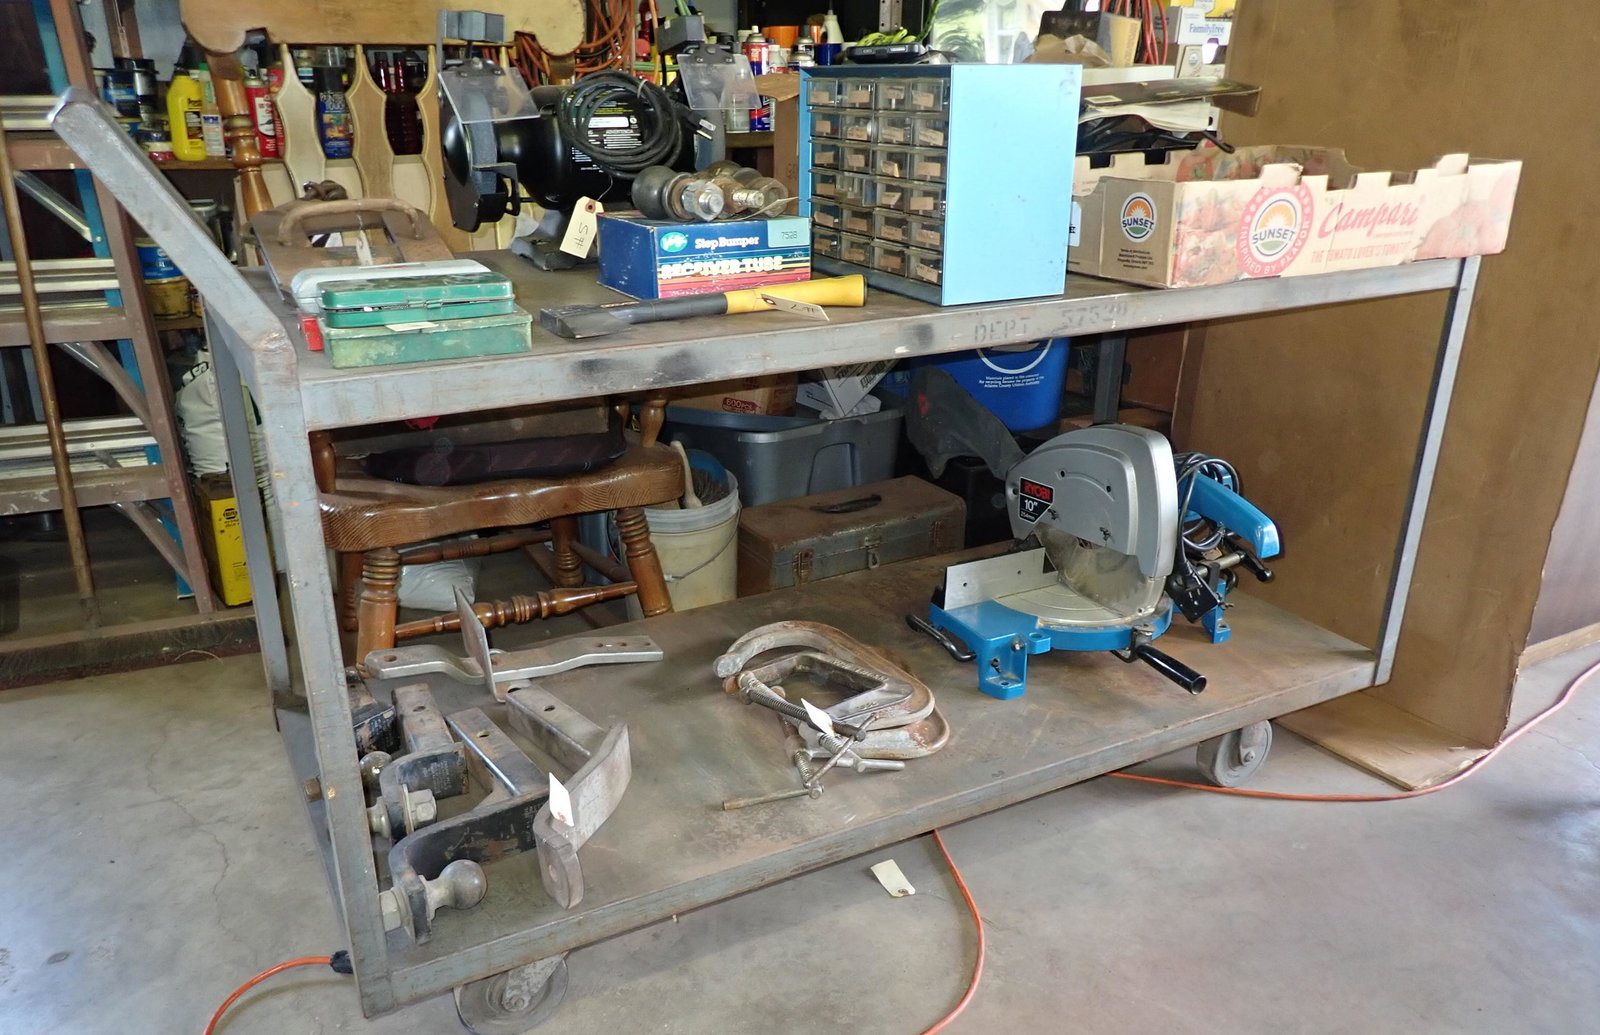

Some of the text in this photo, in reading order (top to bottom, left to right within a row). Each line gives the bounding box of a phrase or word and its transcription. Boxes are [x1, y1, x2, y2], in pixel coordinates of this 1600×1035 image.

[1122, 217, 1154, 230] SUNSET
[1317, 201, 1419, 238] Campari
[694, 237, 718, 250] Step
[718, 236, 760, 247] Bumper
[1252, 228, 1296, 245] SUNSET
[660, 255, 784, 280] RECEIVER TUBE
[1264, 264, 1276, 275] BY
[1023, 480, 1051, 501] RYOBI
